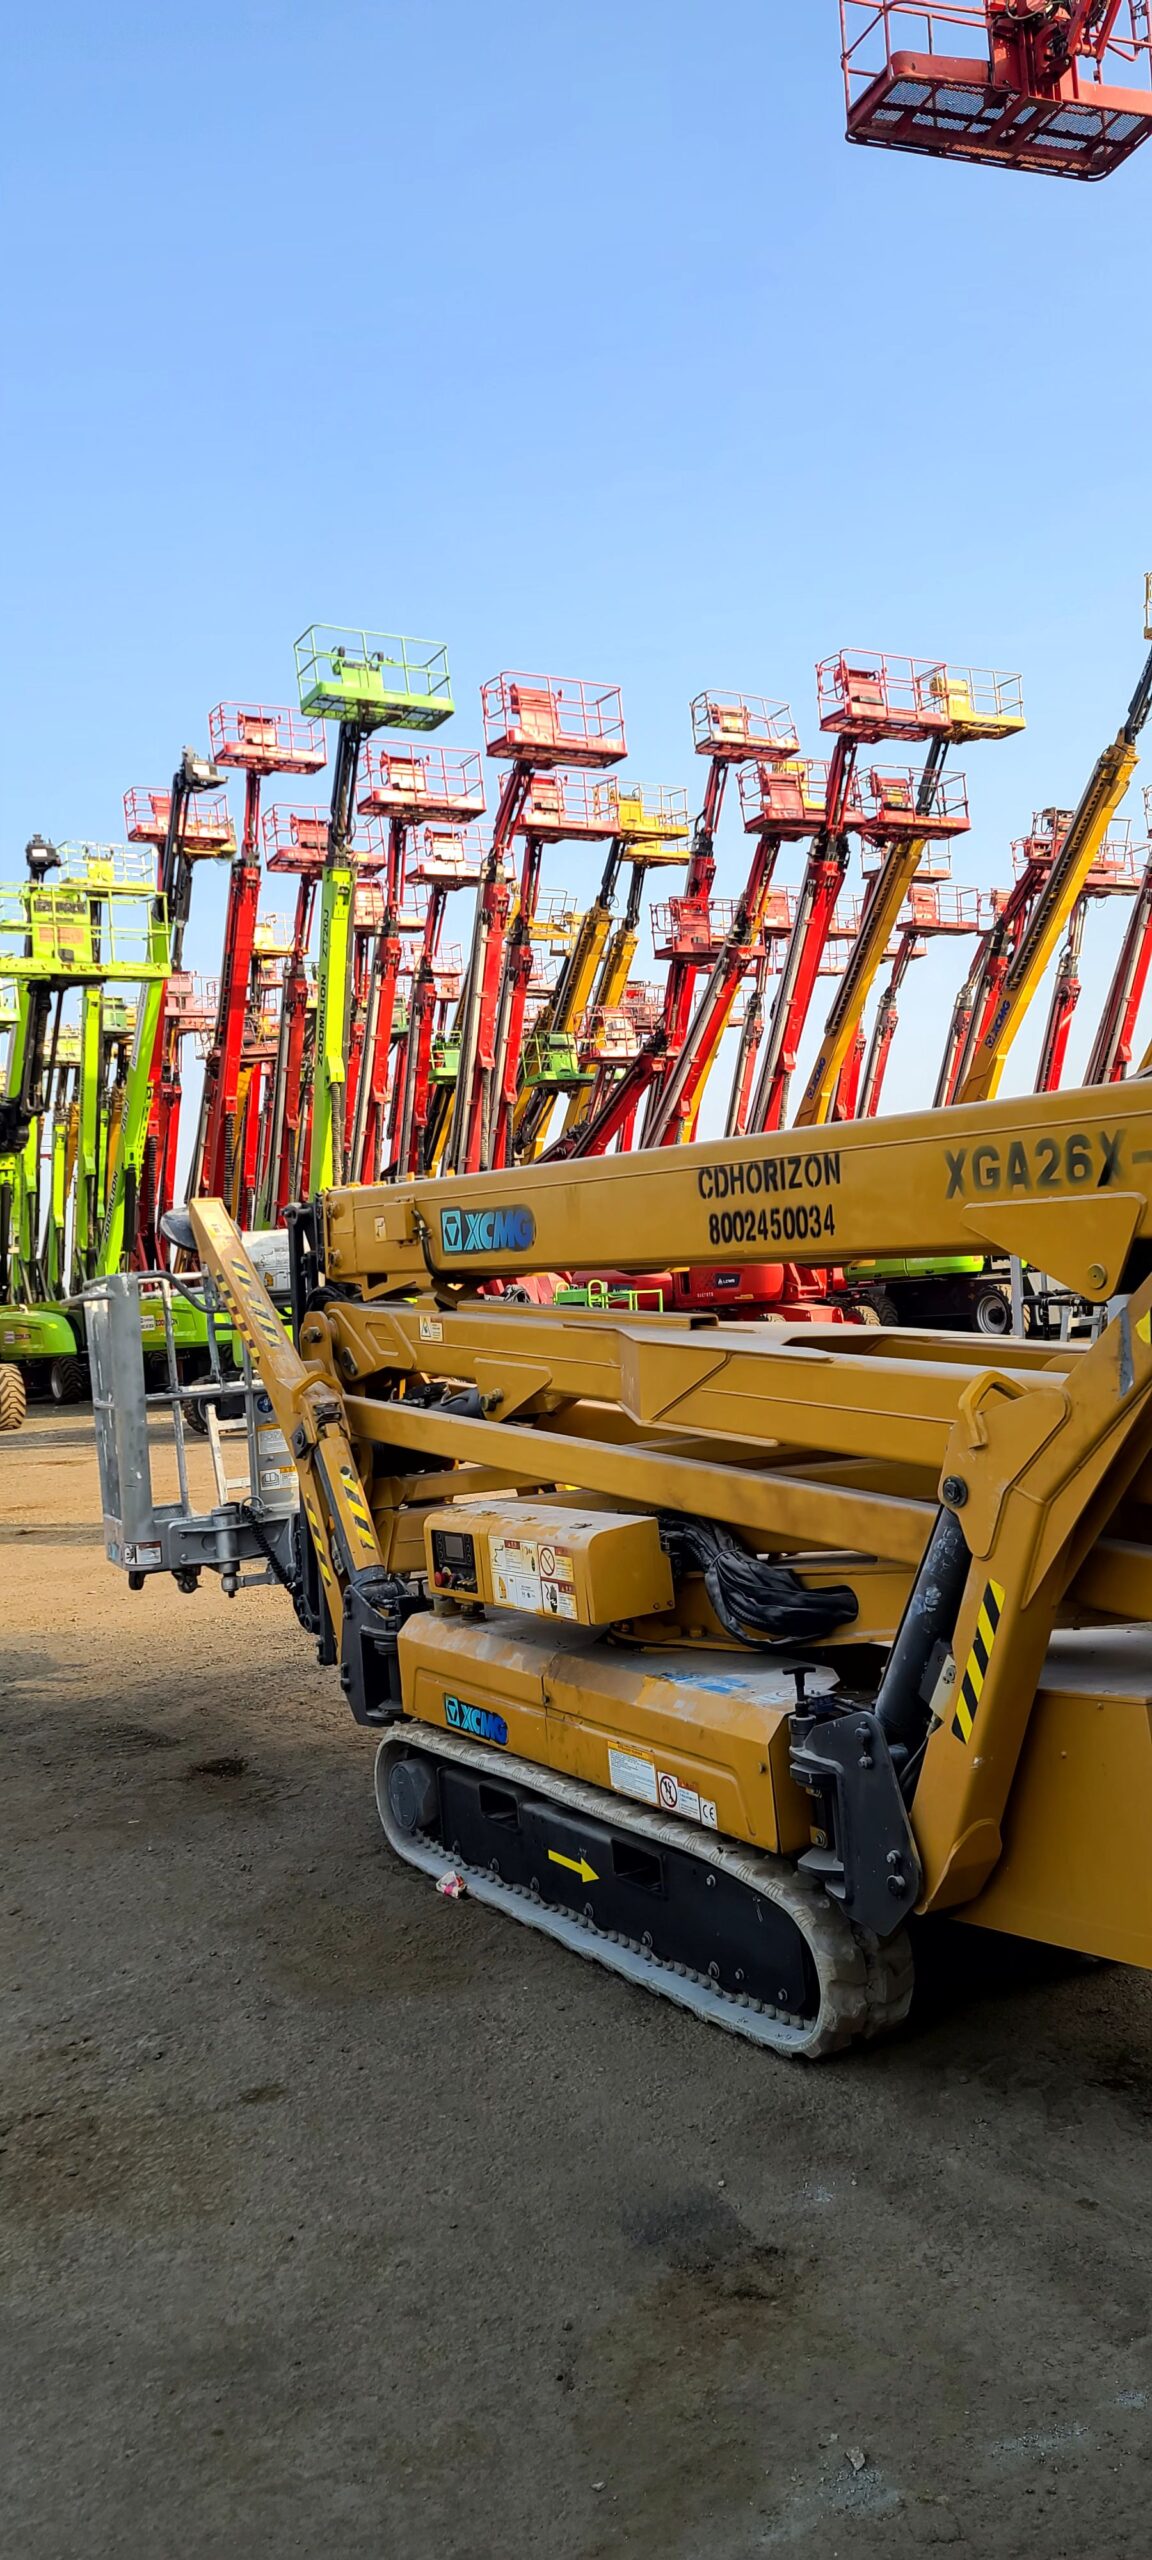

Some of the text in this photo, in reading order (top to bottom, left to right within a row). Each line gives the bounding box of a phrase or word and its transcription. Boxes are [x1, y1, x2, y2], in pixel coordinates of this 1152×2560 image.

[317, 974, 327, 1066] ZOOMLION
[698, 1151, 841, 1199] CDHORIZON
[104, 1171, 119, 1244] ZOOMLION
[708, 1203, 836, 1245] 8002450034
[464, 1209, 535, 1252] XCMG
[460, 1703, 508, 1745] XCMG
